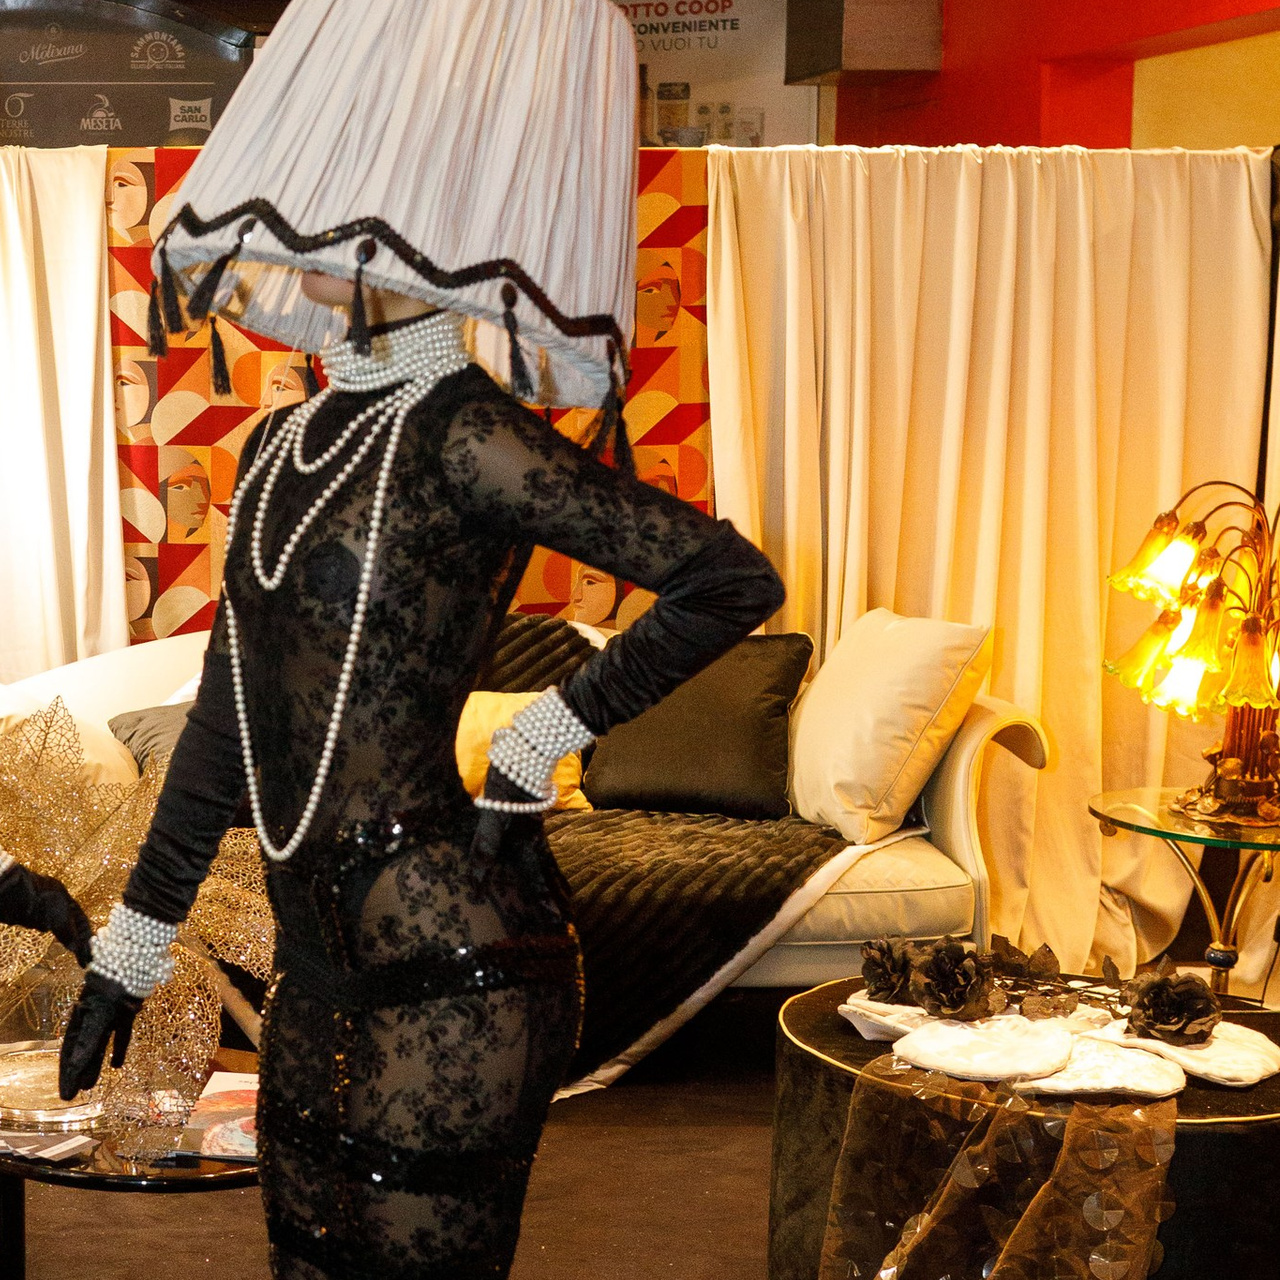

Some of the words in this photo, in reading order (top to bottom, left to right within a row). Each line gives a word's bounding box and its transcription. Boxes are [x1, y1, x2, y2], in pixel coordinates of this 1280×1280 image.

[632, 18, 740, 35] ONVENIENTE
[130, 31, 185, 58] SAMMONTANA
[650, 37, 691, 51] VUOI
[696, 35, 719, 50] TU
[0, 119, 29, 128] TERRE
[80, 117, 122, 131] MESETA
[173, 114, 207, 123] CARLO
